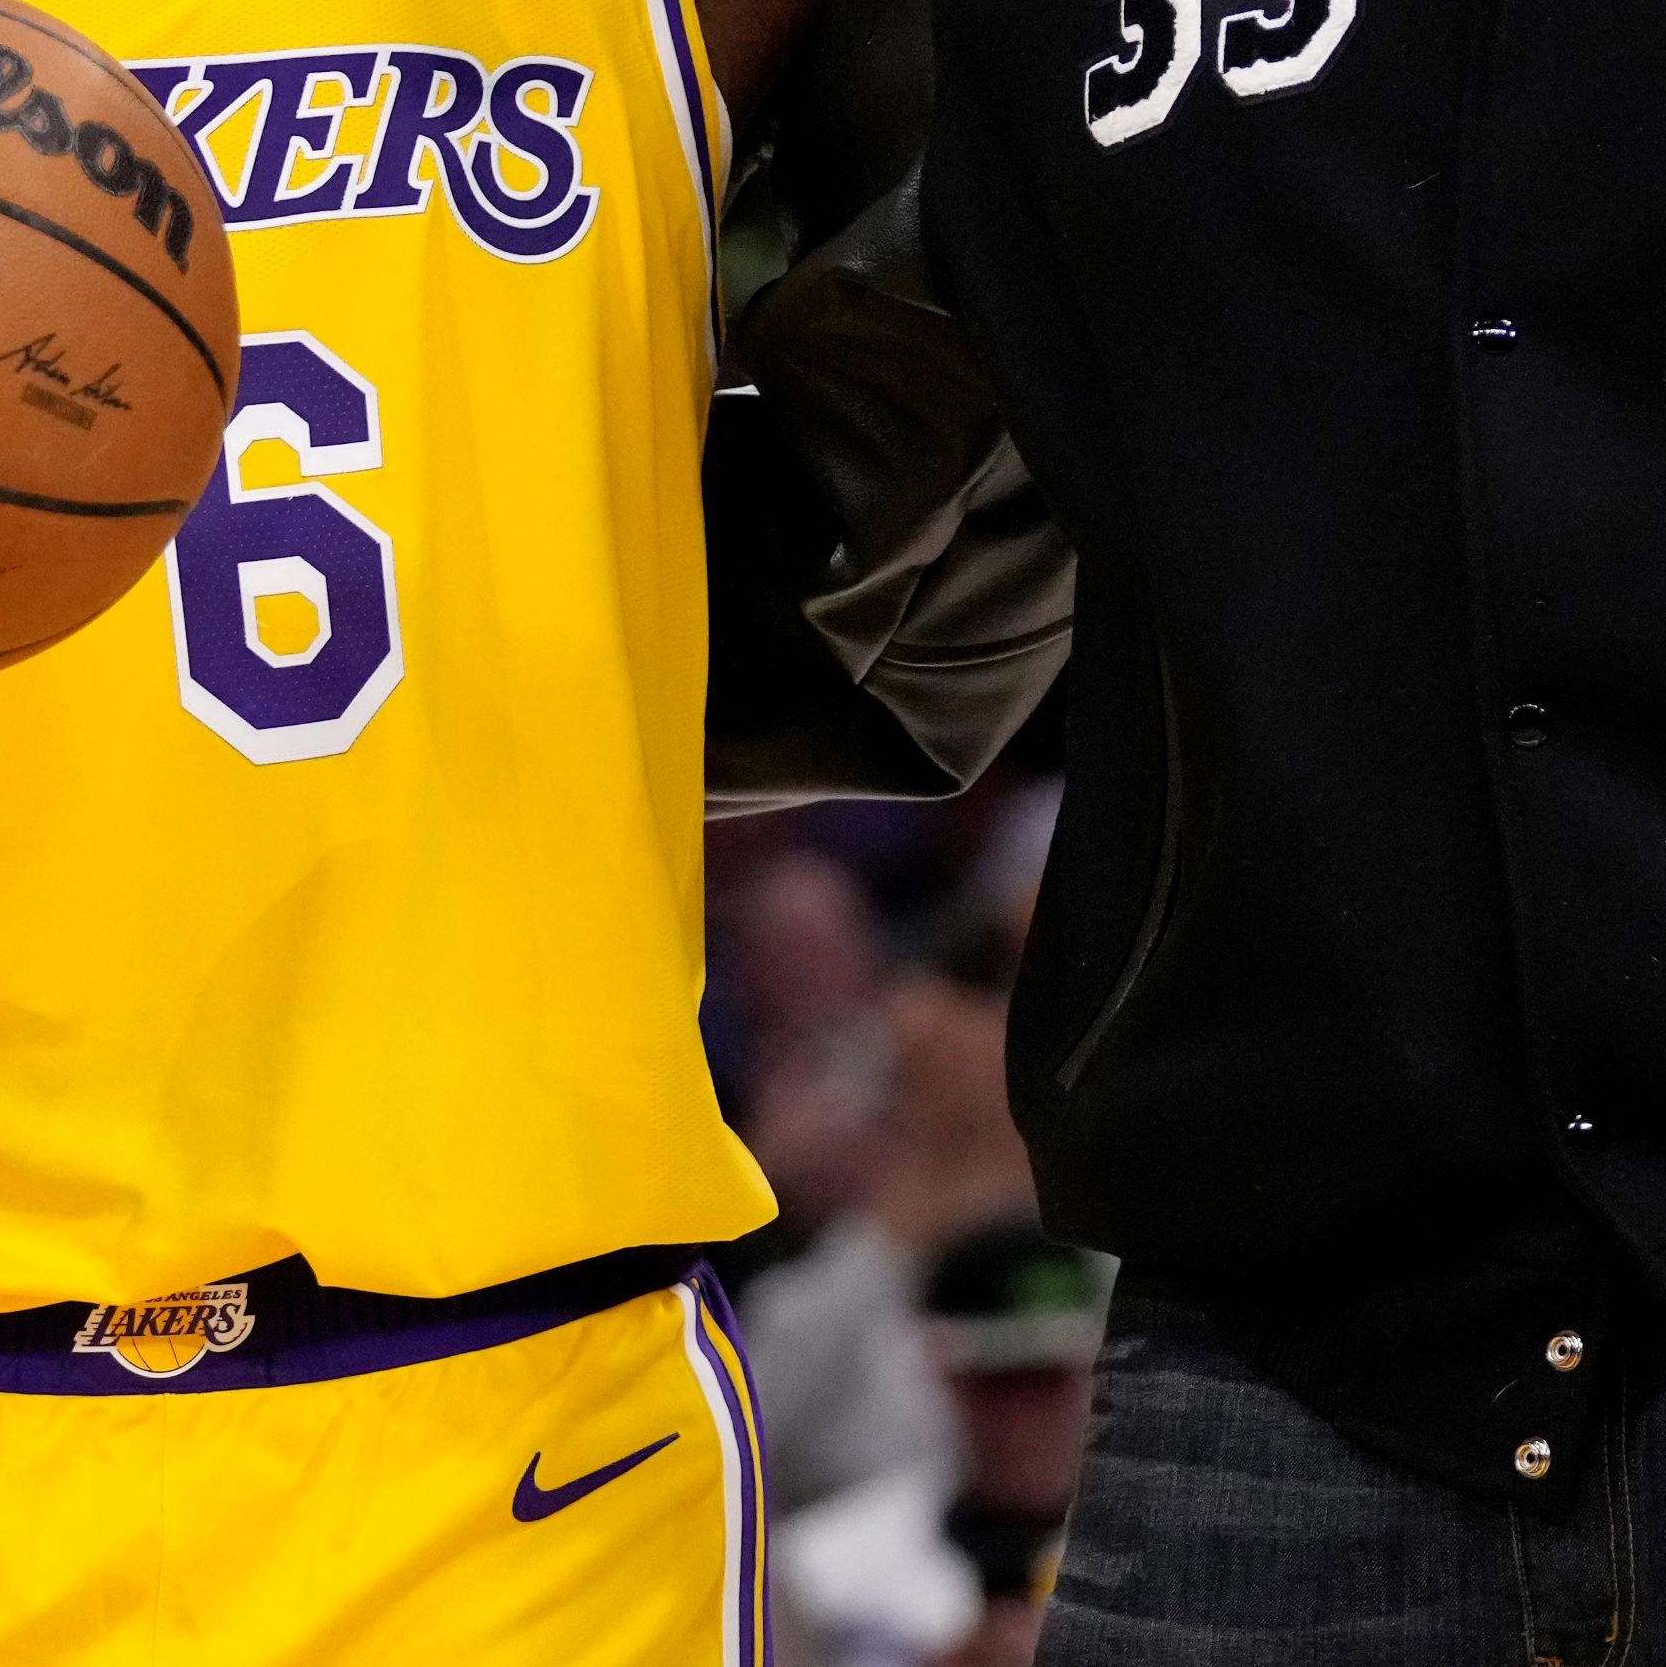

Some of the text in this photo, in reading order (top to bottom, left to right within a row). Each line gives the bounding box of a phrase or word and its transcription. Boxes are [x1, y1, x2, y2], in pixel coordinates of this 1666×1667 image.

[121, 45, 600, 265] KERS
[164, 329, 405, 766] 6
[82, 1303, 248, 1347] LAKERS
[165, 1289, 242, 1302] ANGELES
